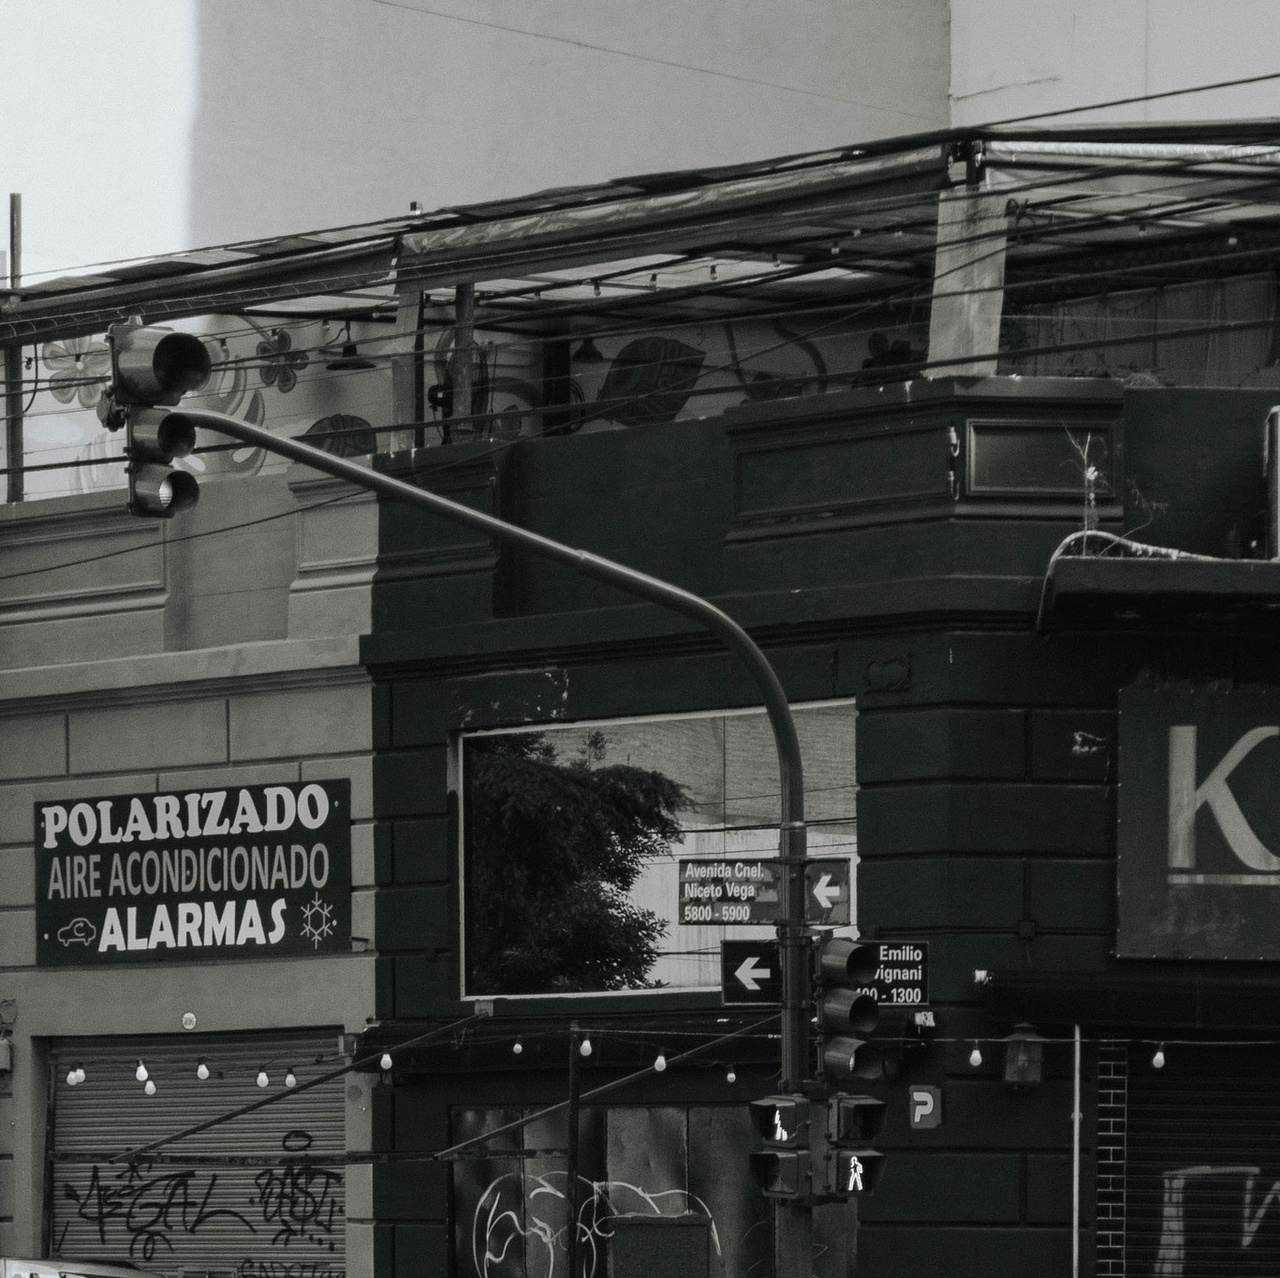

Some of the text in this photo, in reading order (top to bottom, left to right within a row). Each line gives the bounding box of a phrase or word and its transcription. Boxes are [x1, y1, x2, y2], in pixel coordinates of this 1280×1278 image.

[41, 783, 330, 849] POLARIZADO
[48, 843, 330, 900] AIRE ACONDICIONADO
[685, 862, 764, 878] Avenida Cnel.
[684, 882, 755, 901] Niceto Vega
[684, 905, 711, 921] 5800
[722, 905, 750, 921] 5900
[98, 898, 287, 952] ALARMAS
[879, 945, 923, 961] Emilio
[891, 987, 922, 1002] 1300
